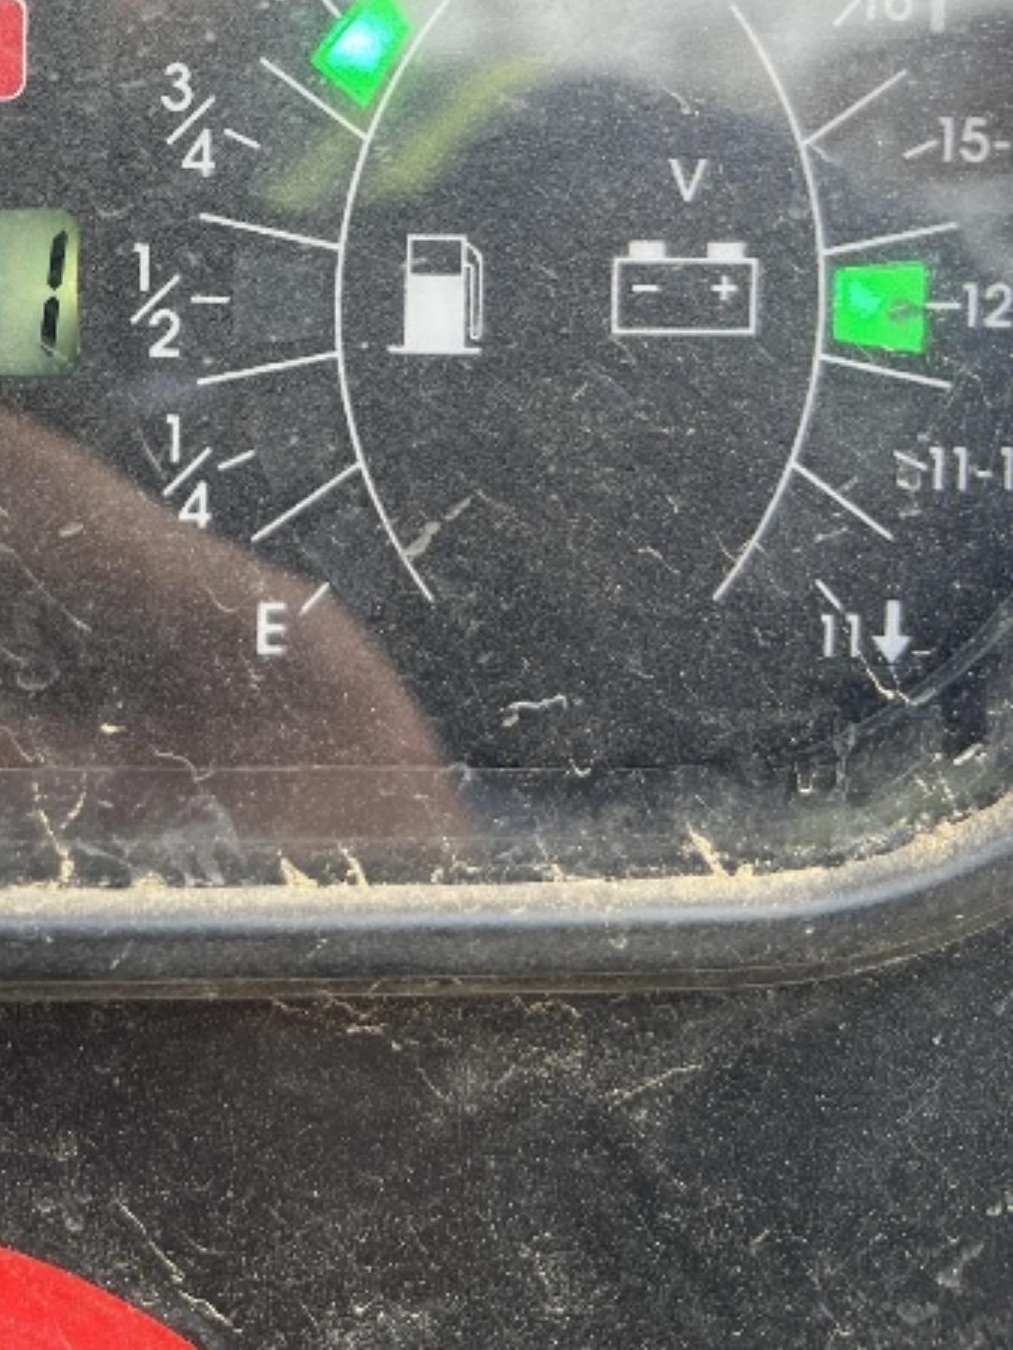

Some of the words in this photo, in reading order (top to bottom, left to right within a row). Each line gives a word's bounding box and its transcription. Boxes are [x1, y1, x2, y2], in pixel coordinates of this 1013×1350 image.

[668, 159, 708, 202] V
[256, 602, 287, 656] E
[822, 614, 860, 656] 11
